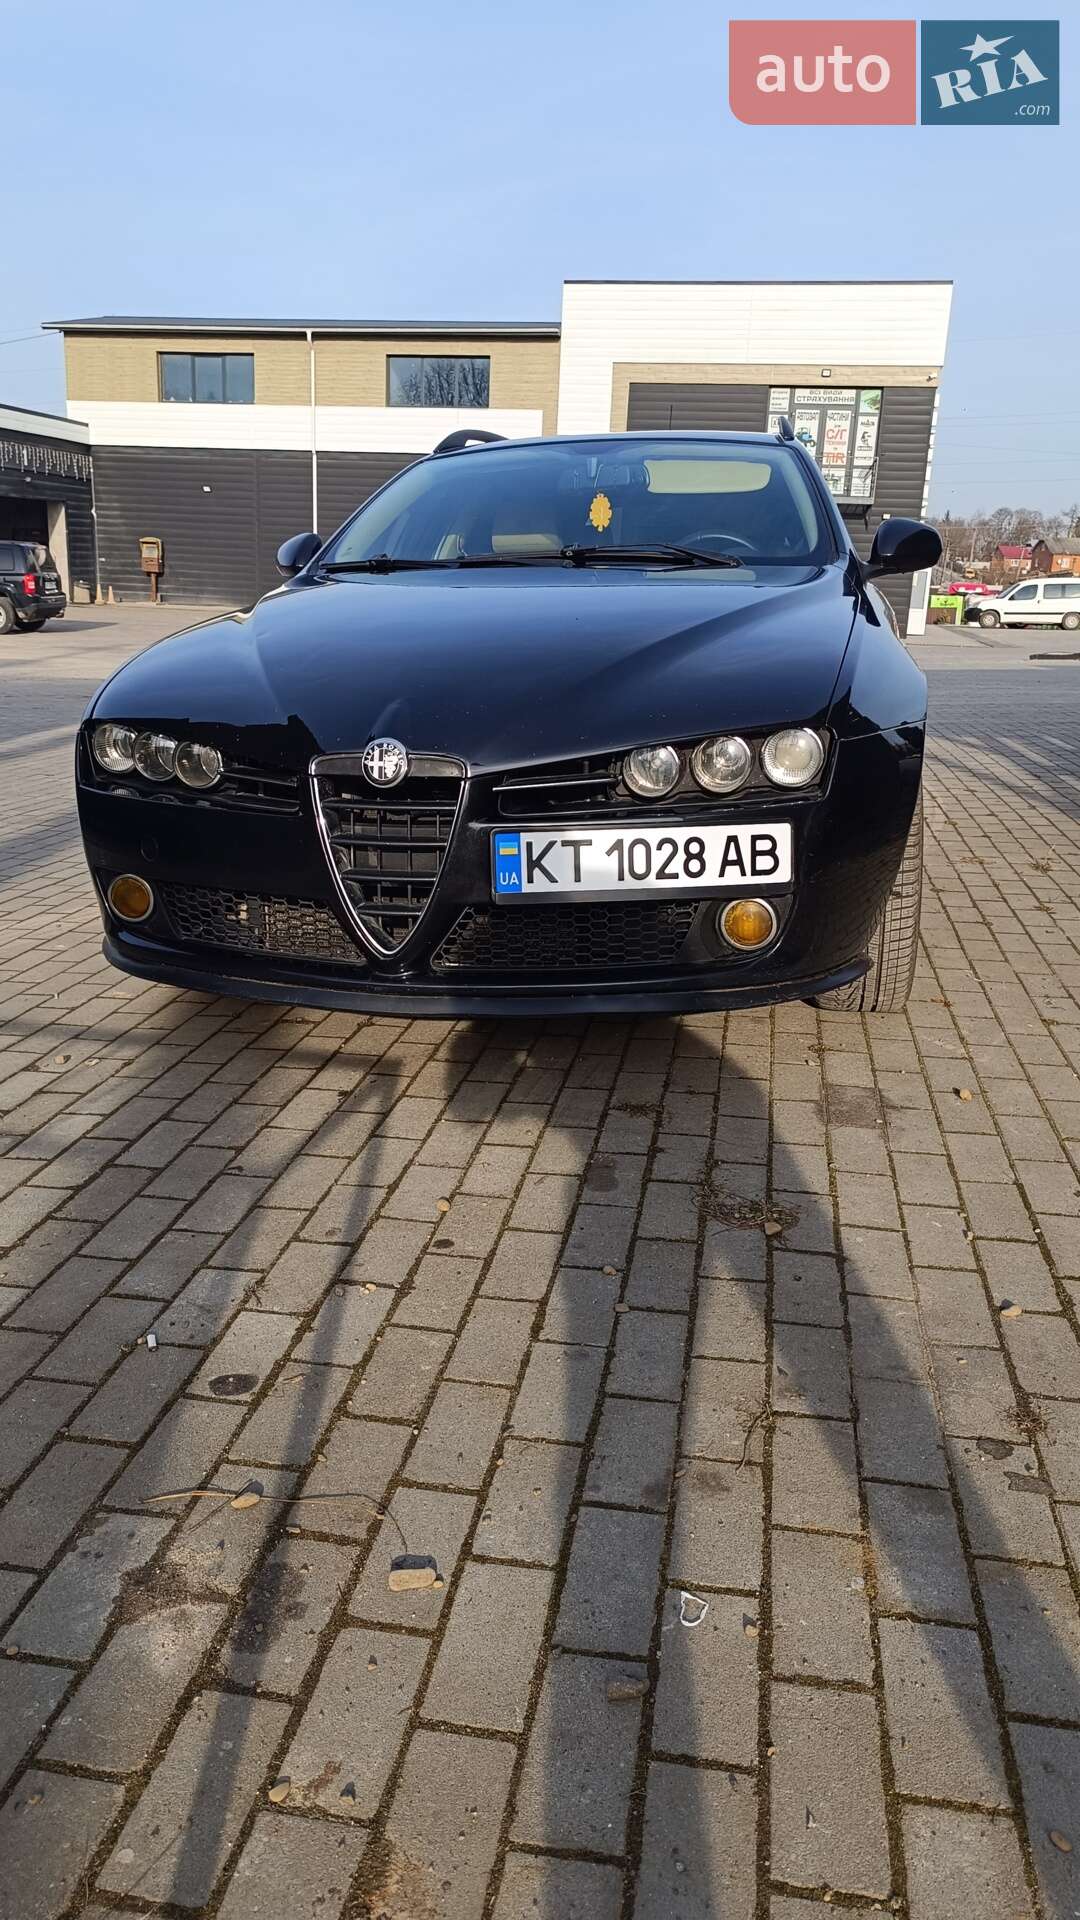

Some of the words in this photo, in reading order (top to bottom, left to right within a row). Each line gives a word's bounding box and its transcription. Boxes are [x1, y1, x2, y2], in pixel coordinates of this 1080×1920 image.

[796, 395, 855, 403] СТРАХУВАННЯ
[823, 452, 845, 464] TIR
[364, 745, 379, 765] ALFA
[383, 743, 404, 765] ROMEO
[526, 839, 593, 884] KT
[605, 836, 706, 882] 1028
[718, 833, 780, 878] AB
[499, 871, 519, 885] UA
